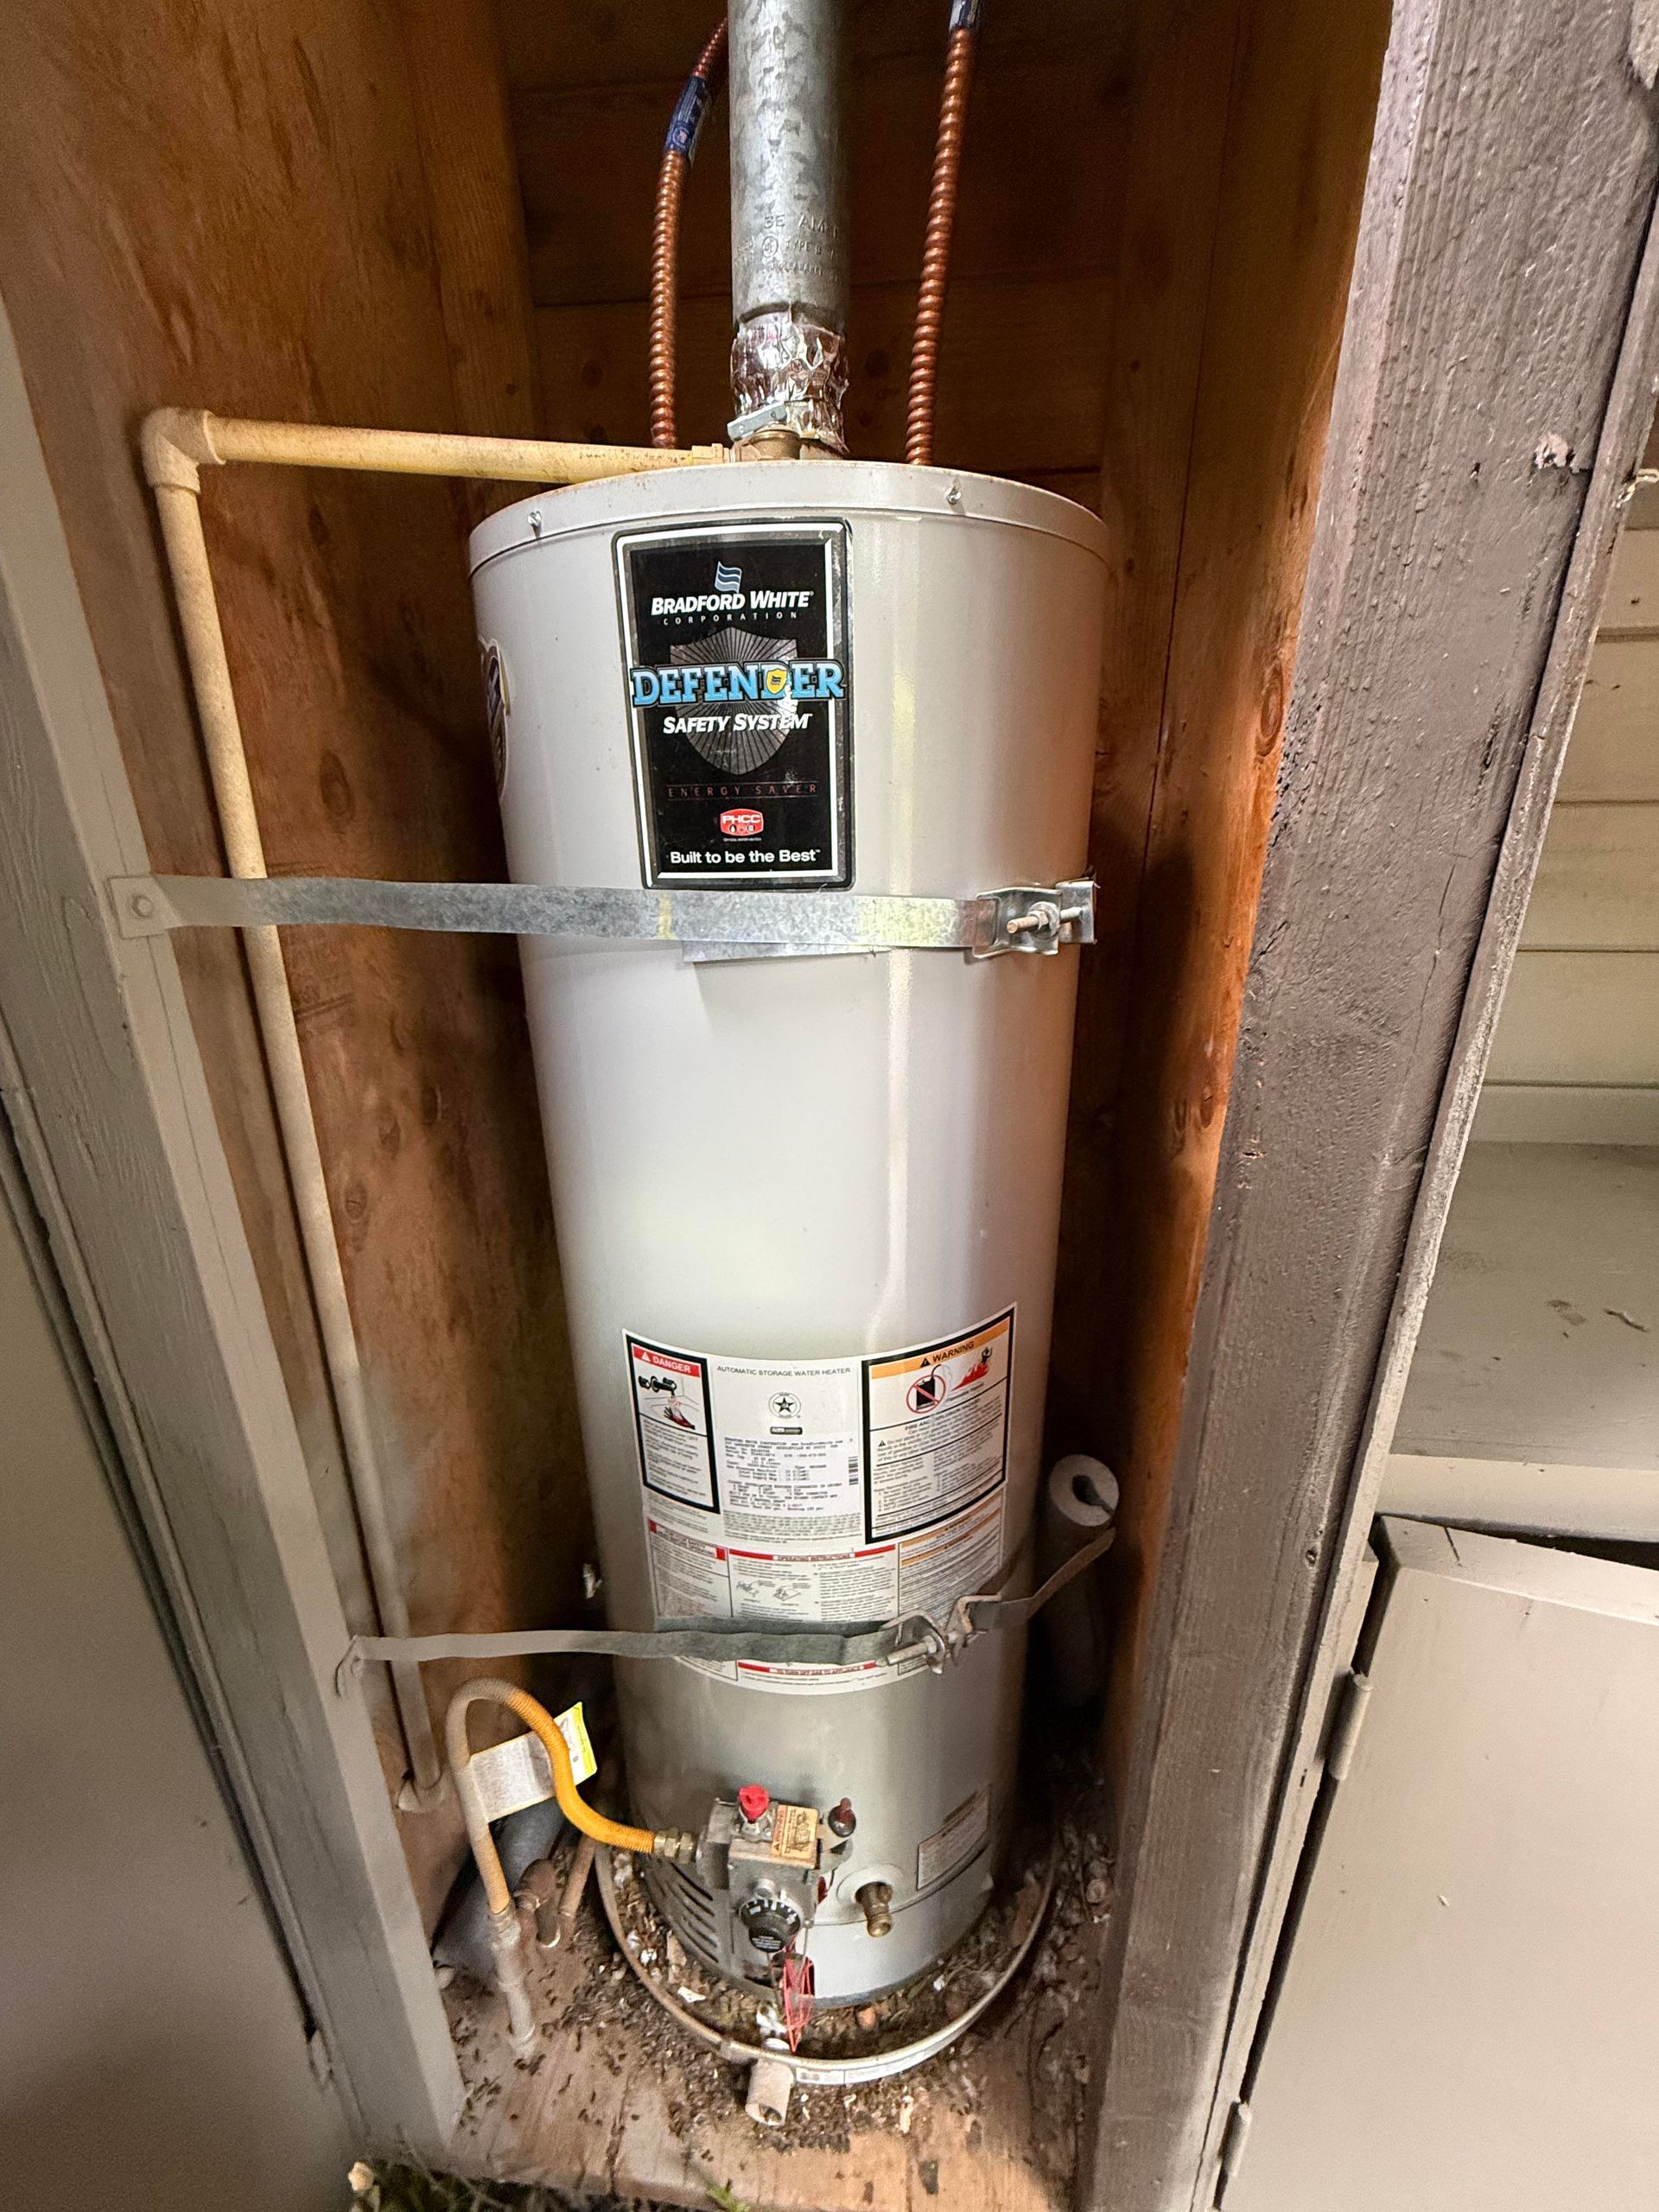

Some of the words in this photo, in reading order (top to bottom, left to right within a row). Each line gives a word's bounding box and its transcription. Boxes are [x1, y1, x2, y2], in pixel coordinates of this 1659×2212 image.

[651, 593, 746, 615] BRADFORD
[749, 590, 810, 609] WHITE
[663, 611, 798, 626] CORPORATION
[632, 661, 845, 706] DEFENDER
[663, 715, 731, 734] SAFETY
[733, 713, 810, 732] SYSTEM
[669, 785, 741, 798] ENERGY
[754, 784, 817, 796] SAVER
[722, 815, 761, 824] PHCC
[670, 851, 702, 864] Built
[704, 852, 721, 863] to
[725, 850, 746, 863] be
[748, 850, 775, 862] the
[779, 849, 817, 862] Best
[932, 1341, 975, 1363] WARNING
[652, 1356, 692, 1374] DANGER
[716, 1365, 757, 1376] AUTOMATIC
[821, 1367, 851, 1376] HEATER
